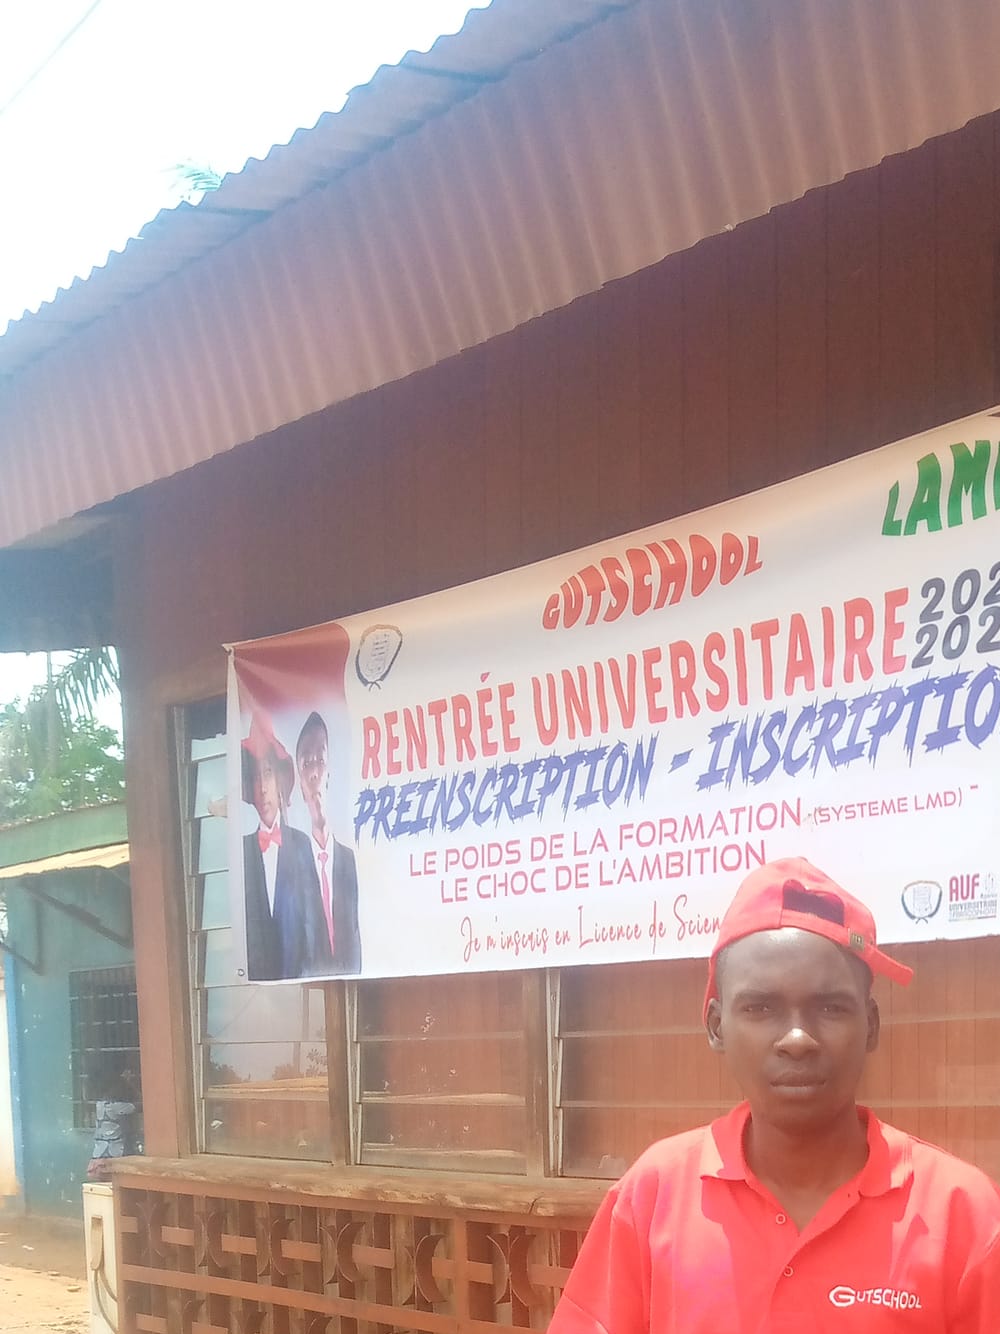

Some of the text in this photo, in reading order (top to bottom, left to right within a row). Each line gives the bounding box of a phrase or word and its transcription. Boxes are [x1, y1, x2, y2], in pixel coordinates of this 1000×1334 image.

[361, 587, 909, 780] RENTRÉE UNIVERSITAIRE
[353, 730, 660, 849] PREINSCRIPTION
[410, 851, 437, 877] LE
[445, 839, 521, 873] POIDS
[530, 833, 564, 862] DE
[573, 828, 609, 857] LA
[619, 797, 801, 850] FORMATION
[812, 797, 908, 826] (SYSTEME
[914, 787, 963, 812] LMD)
[440, 839, 766, 903] LE CHOC DE L'AMBITION
[949, 873, 980, 902] AUF
[460, 916, 481, 963] Je
[486, 915, 550, 957] m'inscris
[555, 927, 571, 946] en
[578, 905, 642, 948] Licence
[649, 900, 667, 955] de
